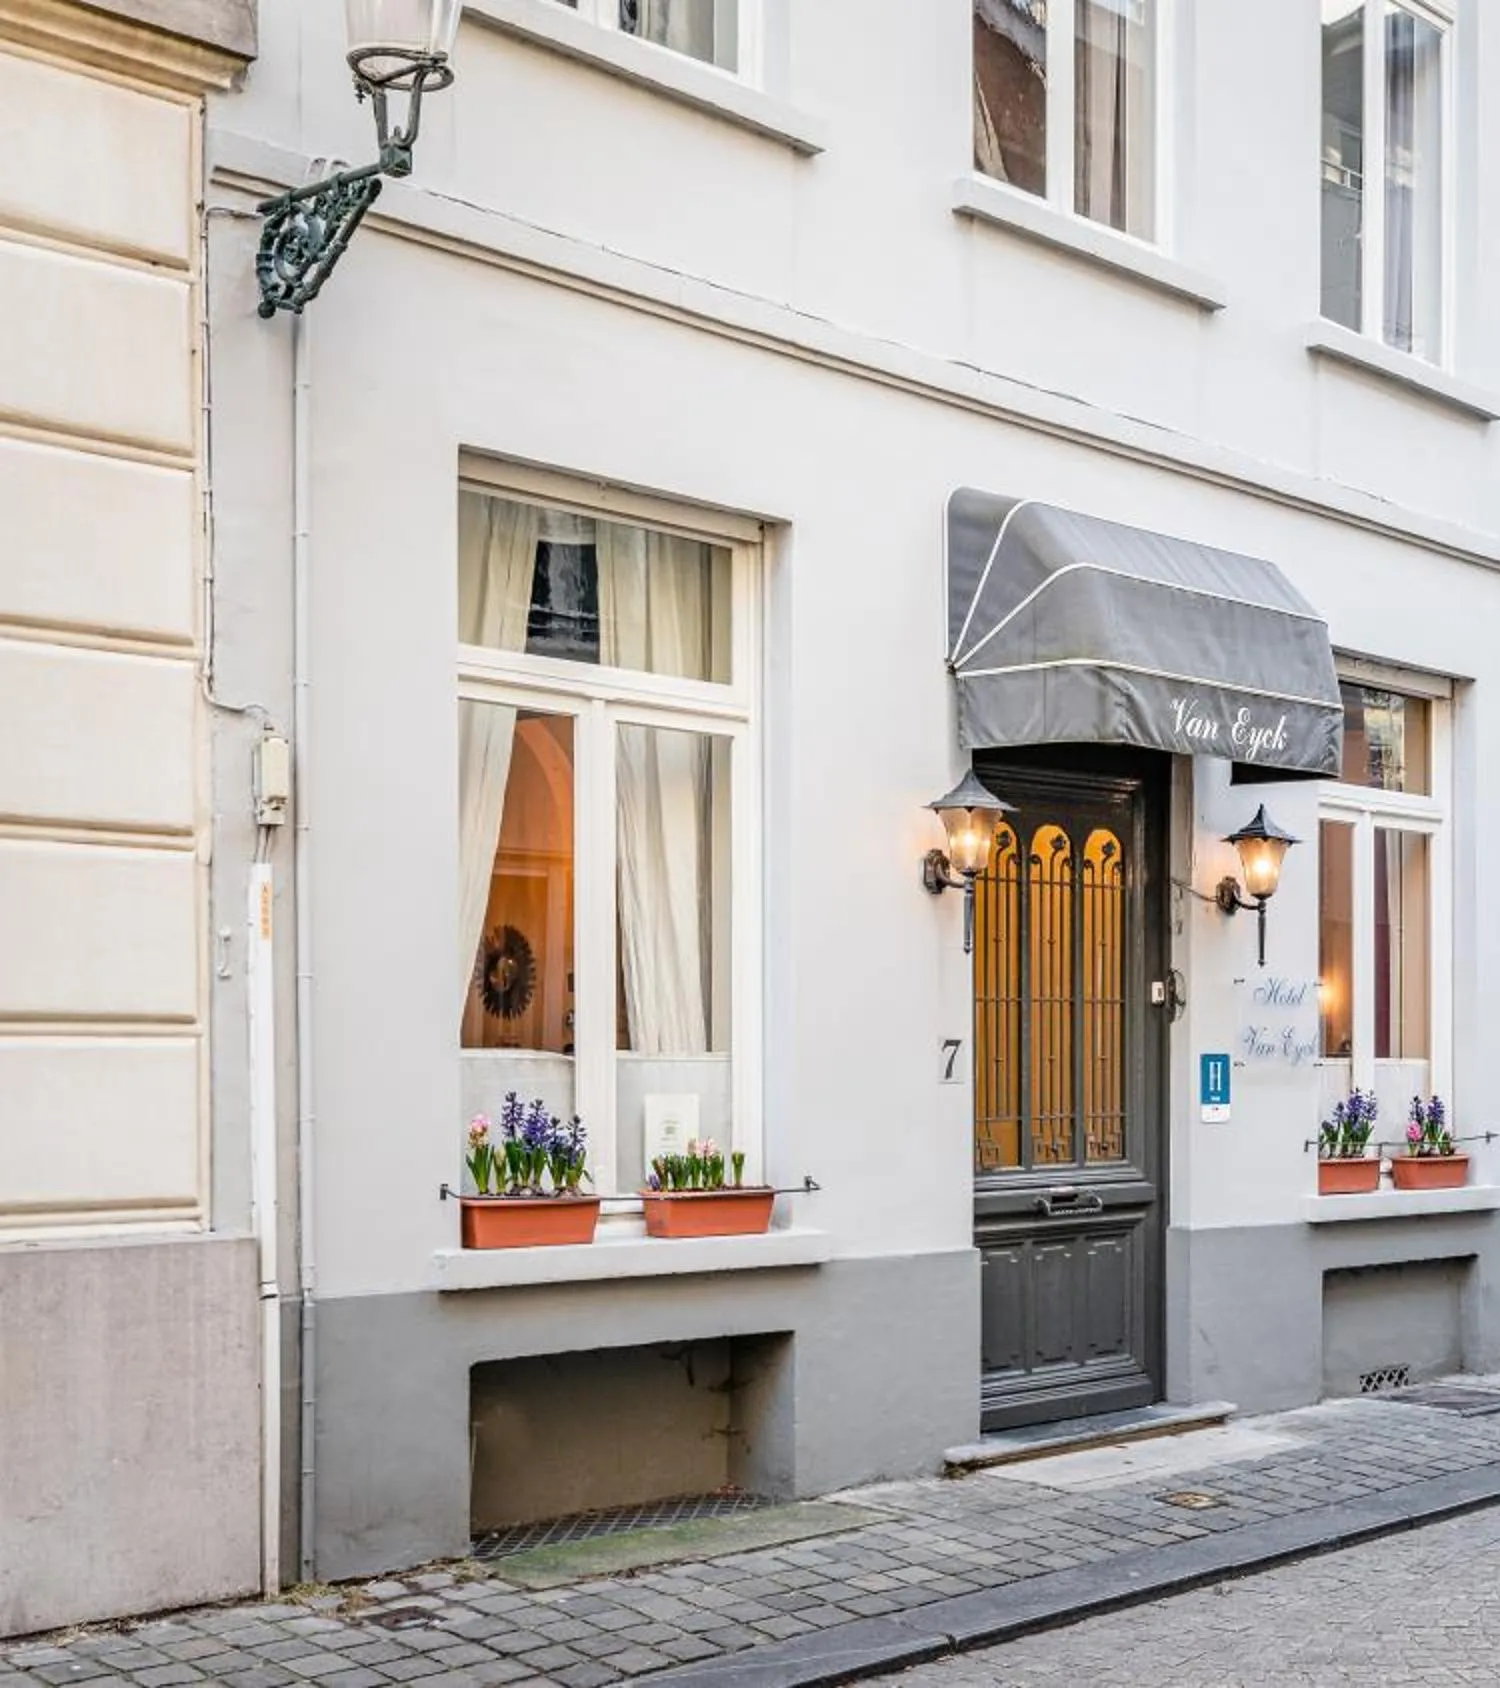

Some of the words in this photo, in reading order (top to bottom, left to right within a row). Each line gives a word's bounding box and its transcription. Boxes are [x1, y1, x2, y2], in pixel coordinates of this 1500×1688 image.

[1169, 698, 1219, 740] Van
[1231, 707, 1288, 760] Eyck
[1253, 976, 1307, 1005] Hotel
[941, 1039, 963, 1081] 7
[1208, 1061, 1223, 1092] H
